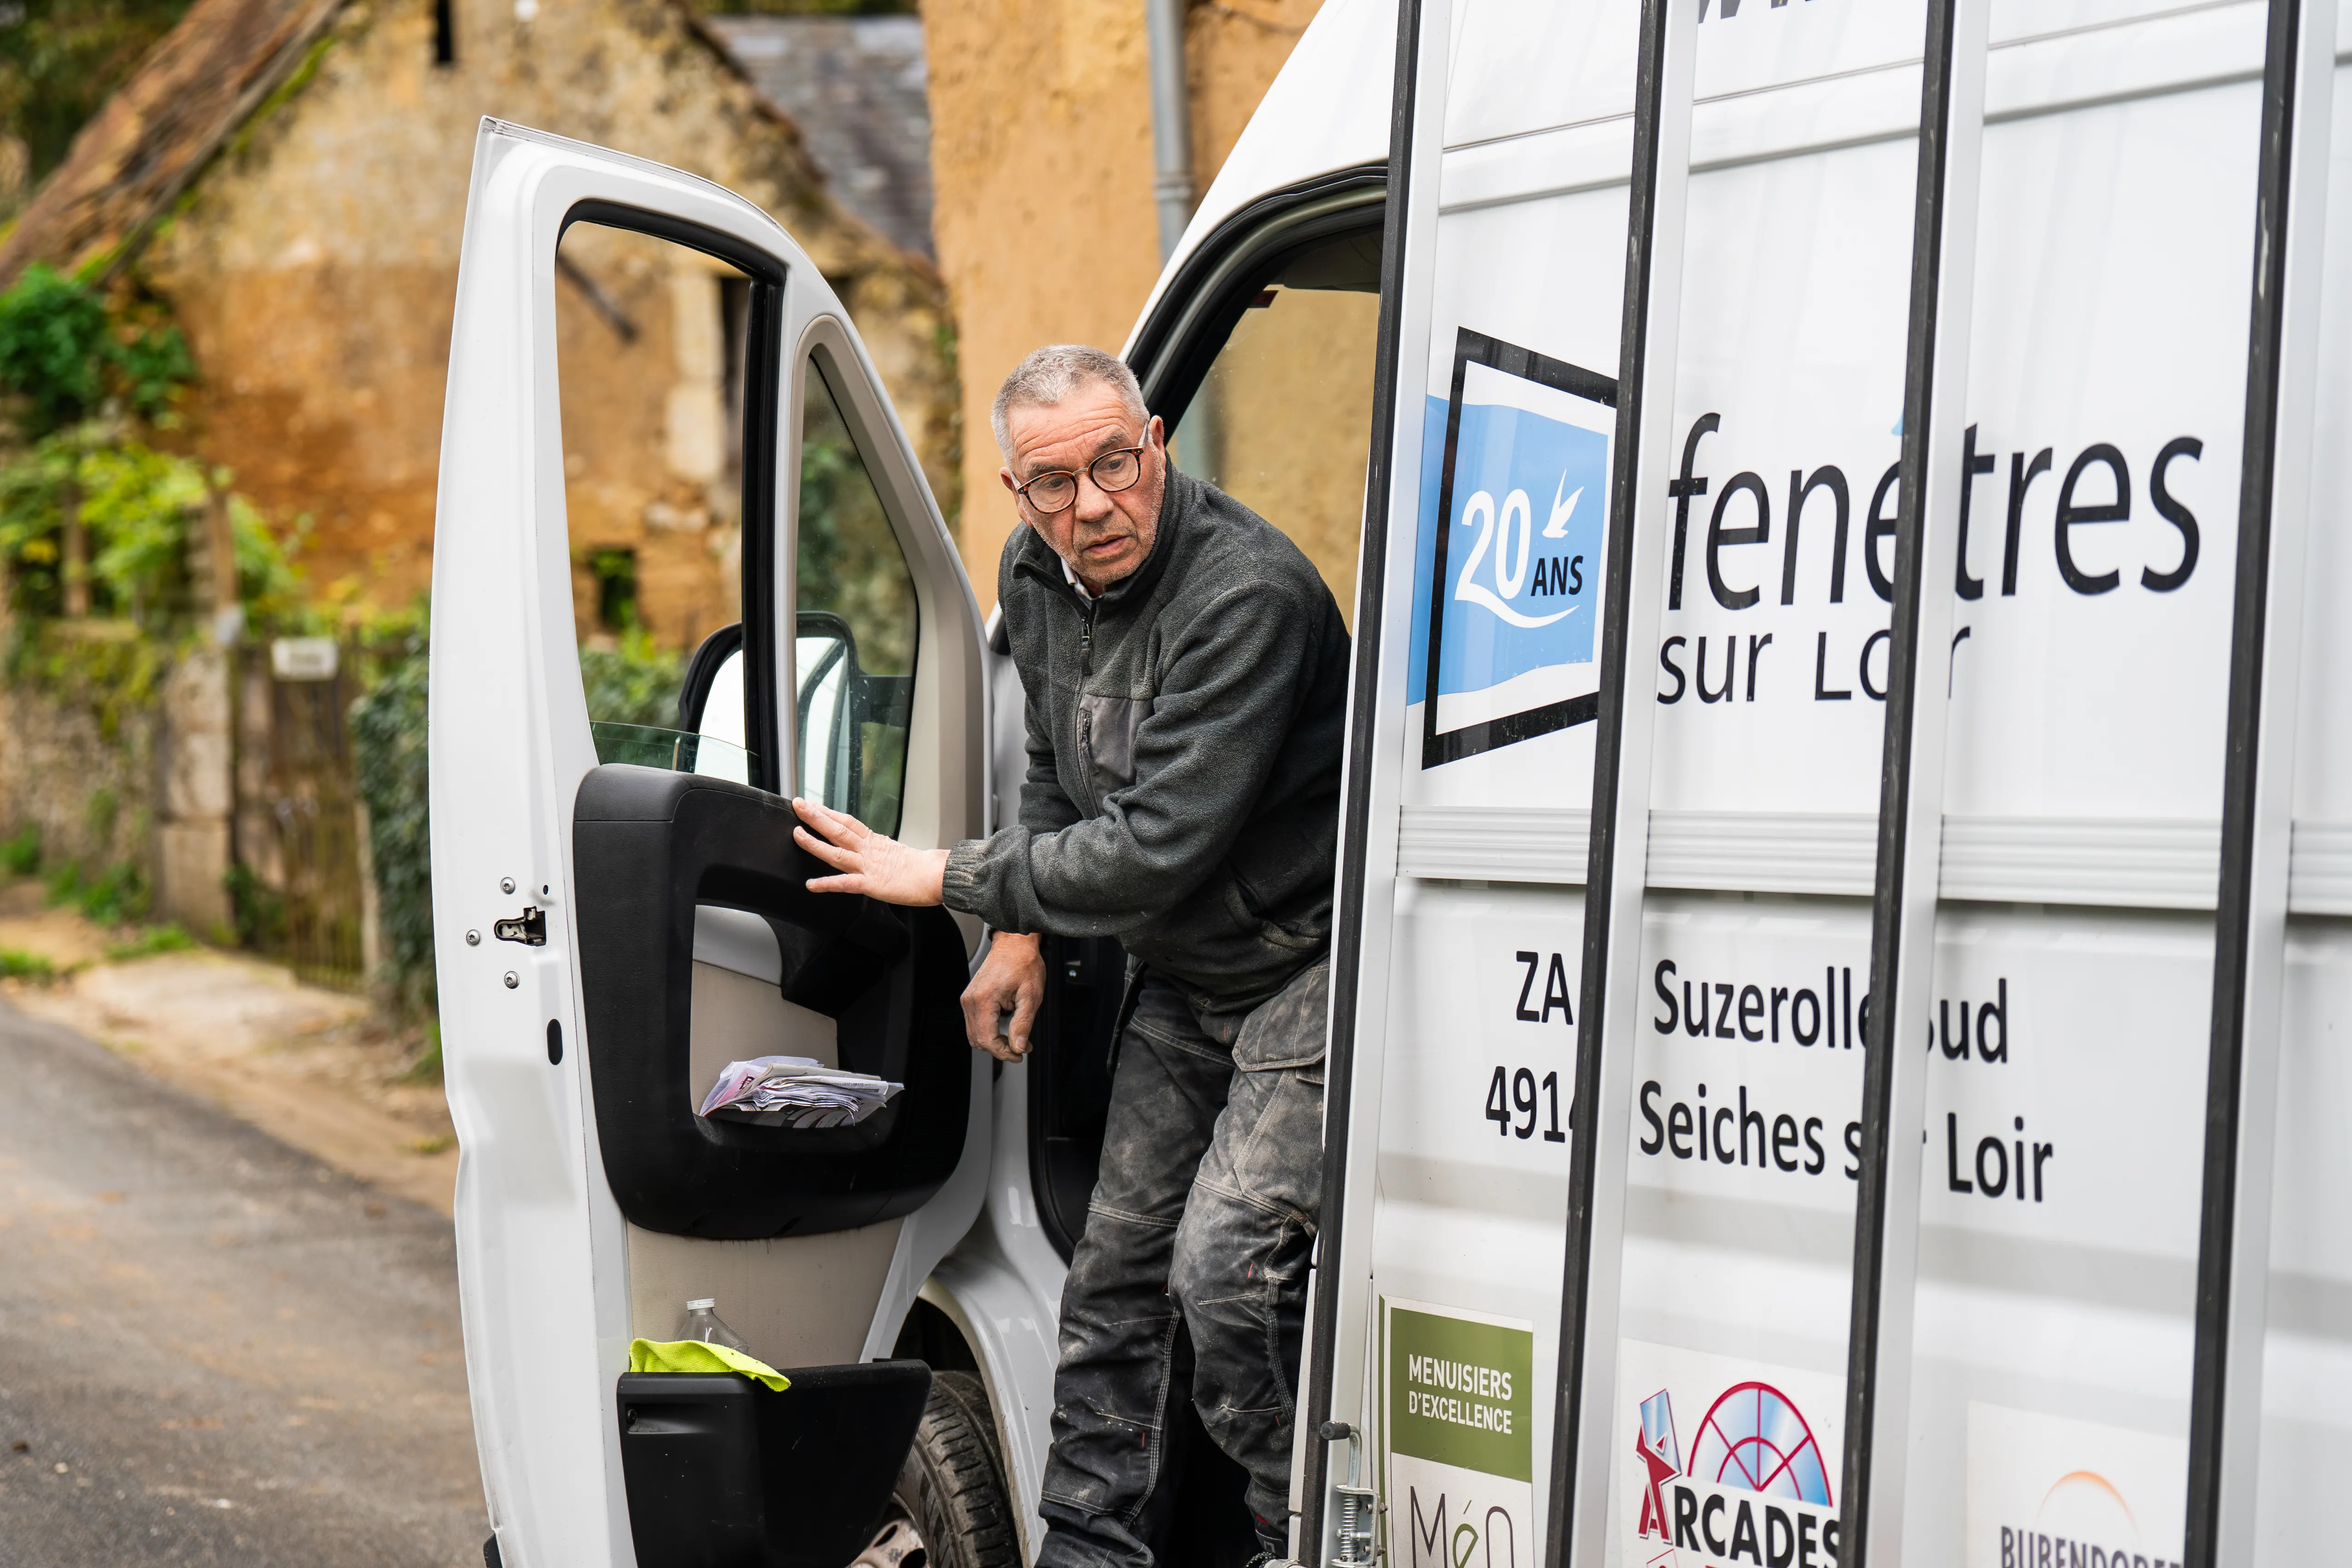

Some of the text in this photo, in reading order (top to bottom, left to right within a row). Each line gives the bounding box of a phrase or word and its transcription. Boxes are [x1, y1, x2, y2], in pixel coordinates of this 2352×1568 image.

[1454, 488, 1584, 620] 20 ANS
[1656, 626, 1971, 705] sur Lor
[1515, 950, 1574, 1025] ZA
[1927, 977, 2007, 1064] ud
[1486, 1065, 1574, 1143] 491
[1639, 1080, 1825, 1176] Seiches
[1948, 1112, 2053, 1203] Loir
[1409, 1353, 1513, 1401] MENUISIERS
[2001, 1525, 2184, 1568] BUBEND
